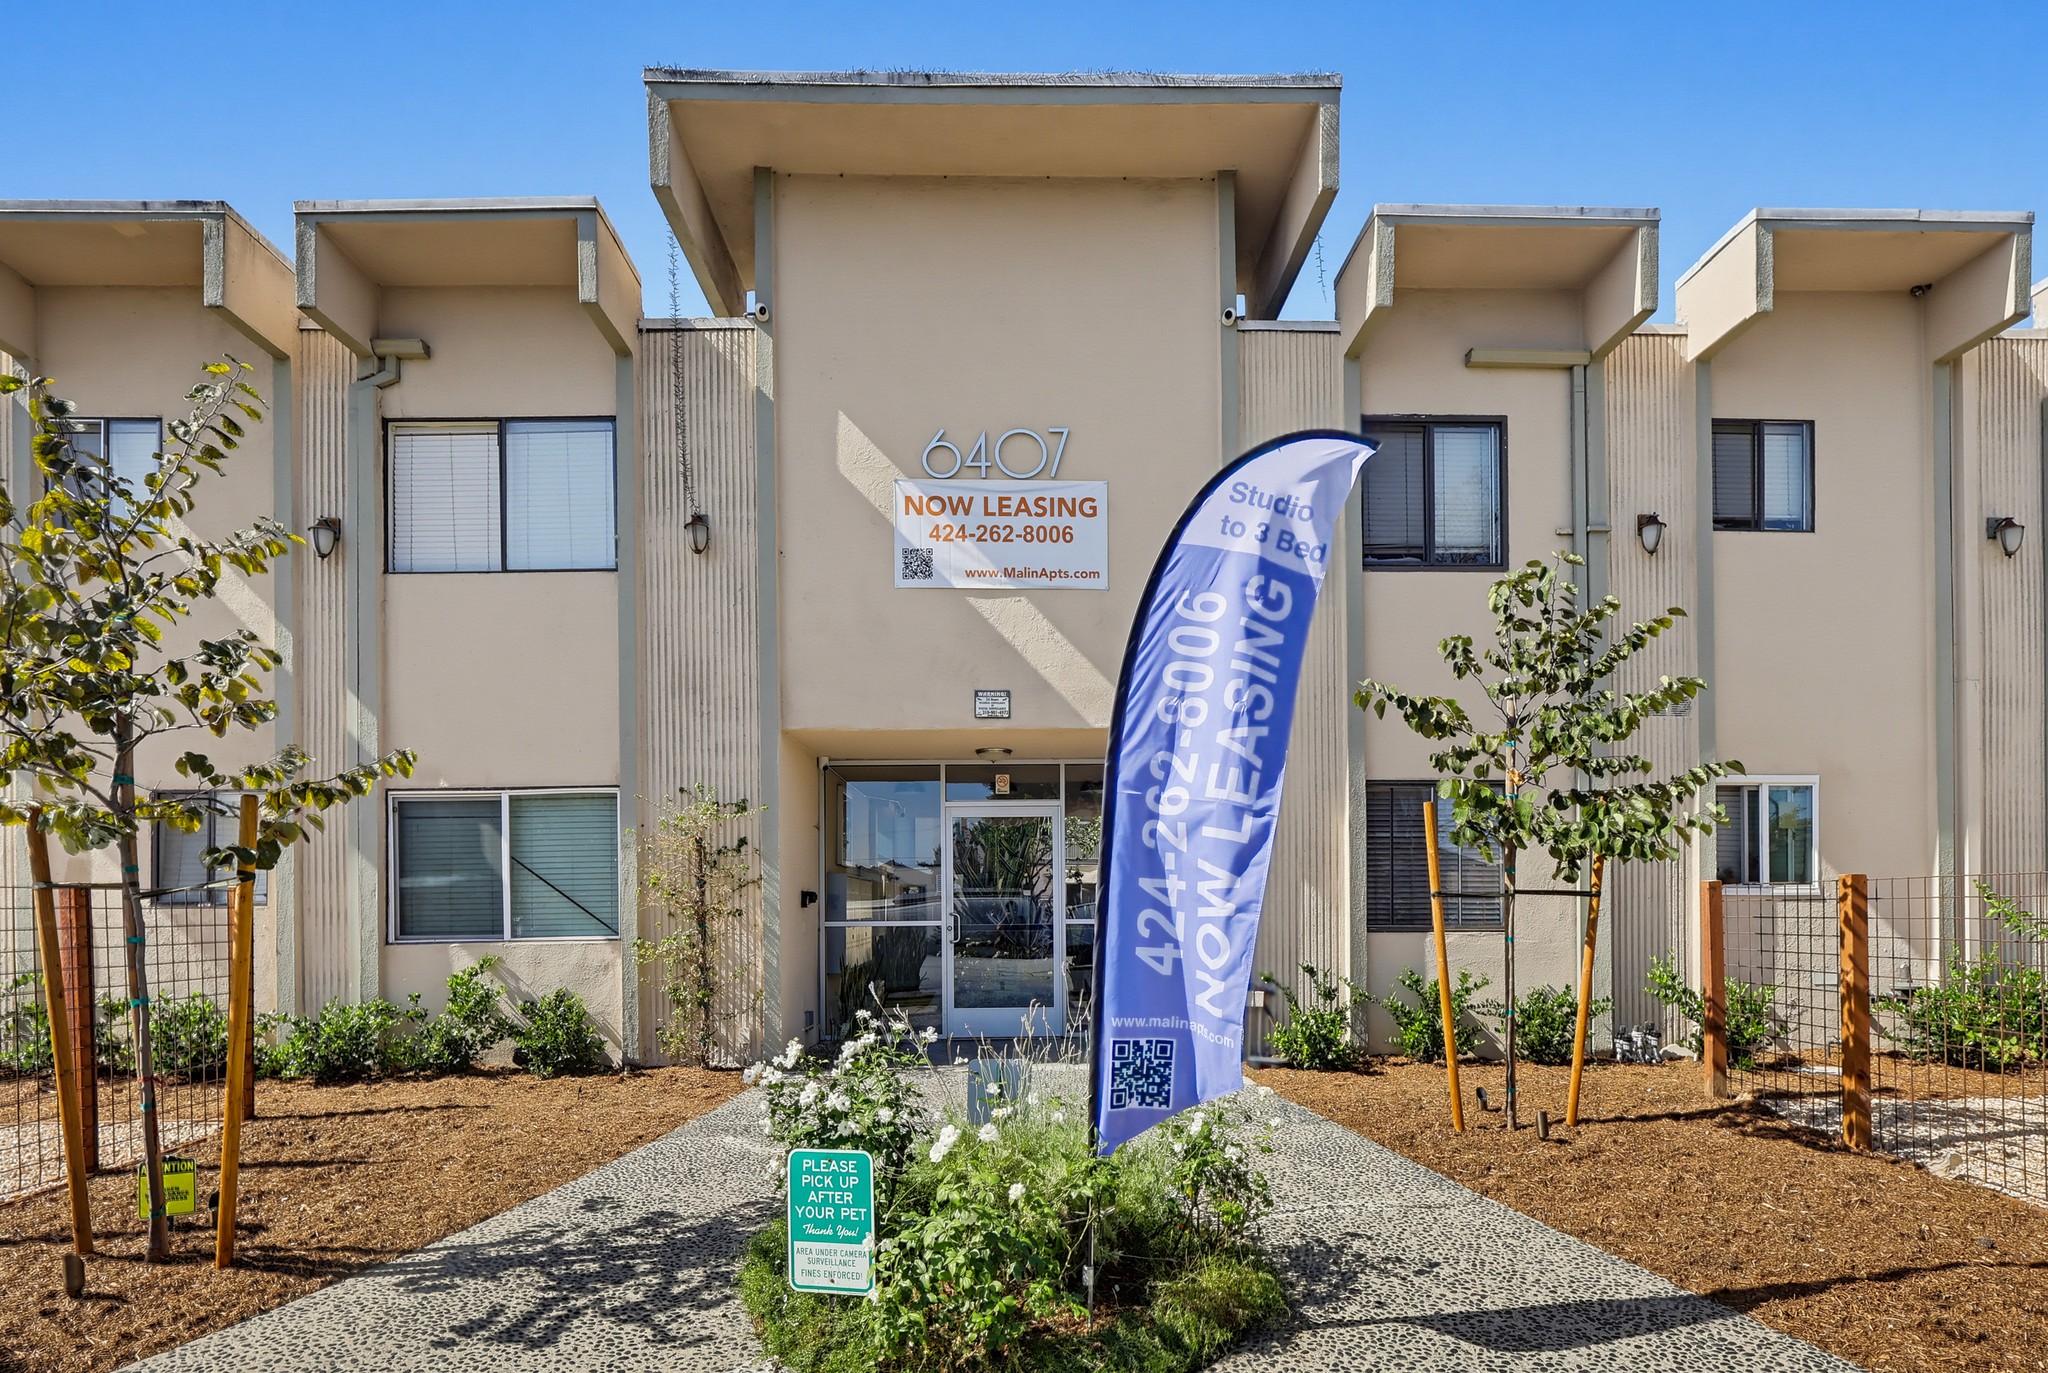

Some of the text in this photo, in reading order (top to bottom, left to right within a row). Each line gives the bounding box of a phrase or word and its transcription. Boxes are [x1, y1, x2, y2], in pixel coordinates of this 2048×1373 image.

[921, 427, 1070, 479] 6407
[904, 495, 1098, 518] NOW LEASING
[1229, 481, 1315, 523] Studio
[929, 524, 1074, 543] 424-262-8006
[1220, 515, 1327, 563] to 3 Bed
[965, 567, 1100, 581] www.MalinApts.com
[1135, 590, 1227, 976] 424-262-8006
[1195, 575, 1293, 1018] NOW LEASING
[141, 1160, 194, 1175] ANTION
[802, 1159, 857, 1173] PLEASE
[801, 1175, 859, 1189] PICK UP
[807, 1190, 853, 1204] AFTER
[795, 1205, 867, 1221] YOUR PET
[802, 1223, 859, 1240] Thank You!
[796, 1247, 867, 1258] AREA UNDER CAMERA
[807, 1257, 856, 1268] SURVEILLANCE
[801, 1269, 863, 1281] FINES ENFORCED!
